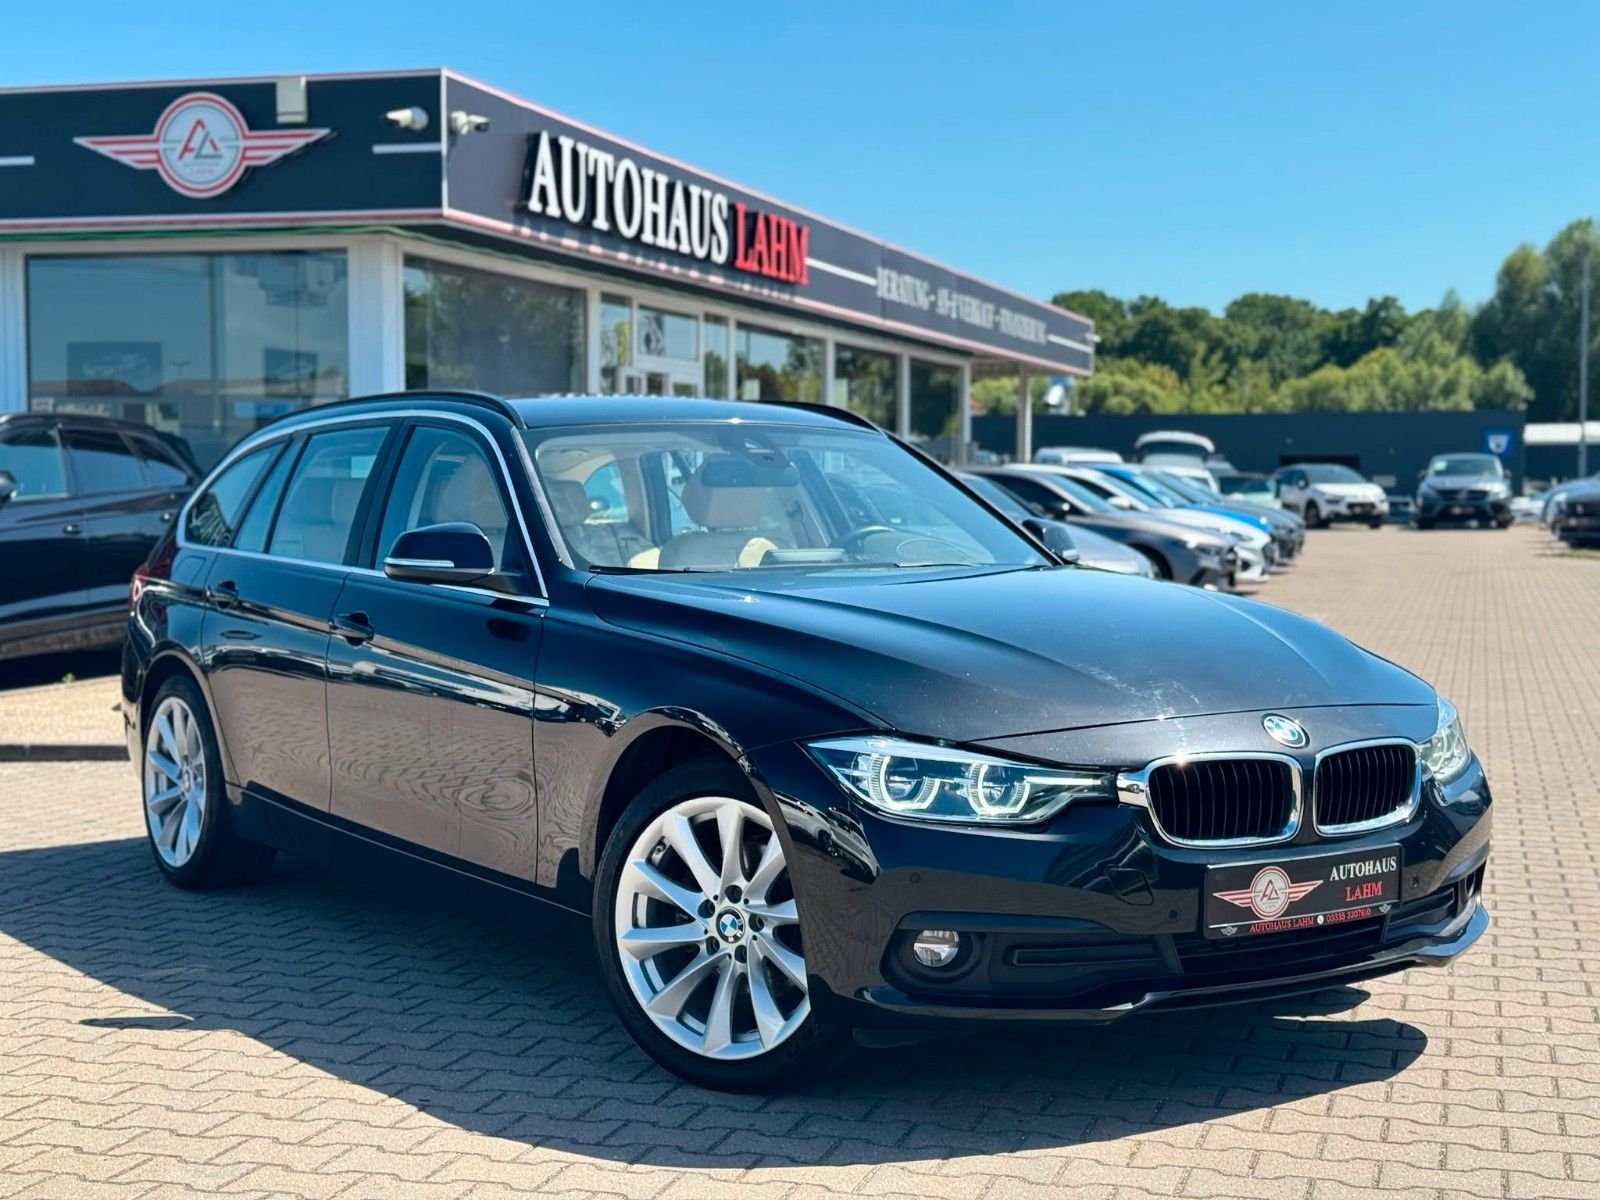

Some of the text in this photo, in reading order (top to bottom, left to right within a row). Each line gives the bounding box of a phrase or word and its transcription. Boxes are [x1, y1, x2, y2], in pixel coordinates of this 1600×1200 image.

[528, 130, 810, 286] AUTOHAUS LAHM
[1330, 856, 1397, 902] AUTOHAUS LAHM
[1250, 919, 1292, 933] AUTOHAUS
[1293, 917, 1315, 928] LAHM
